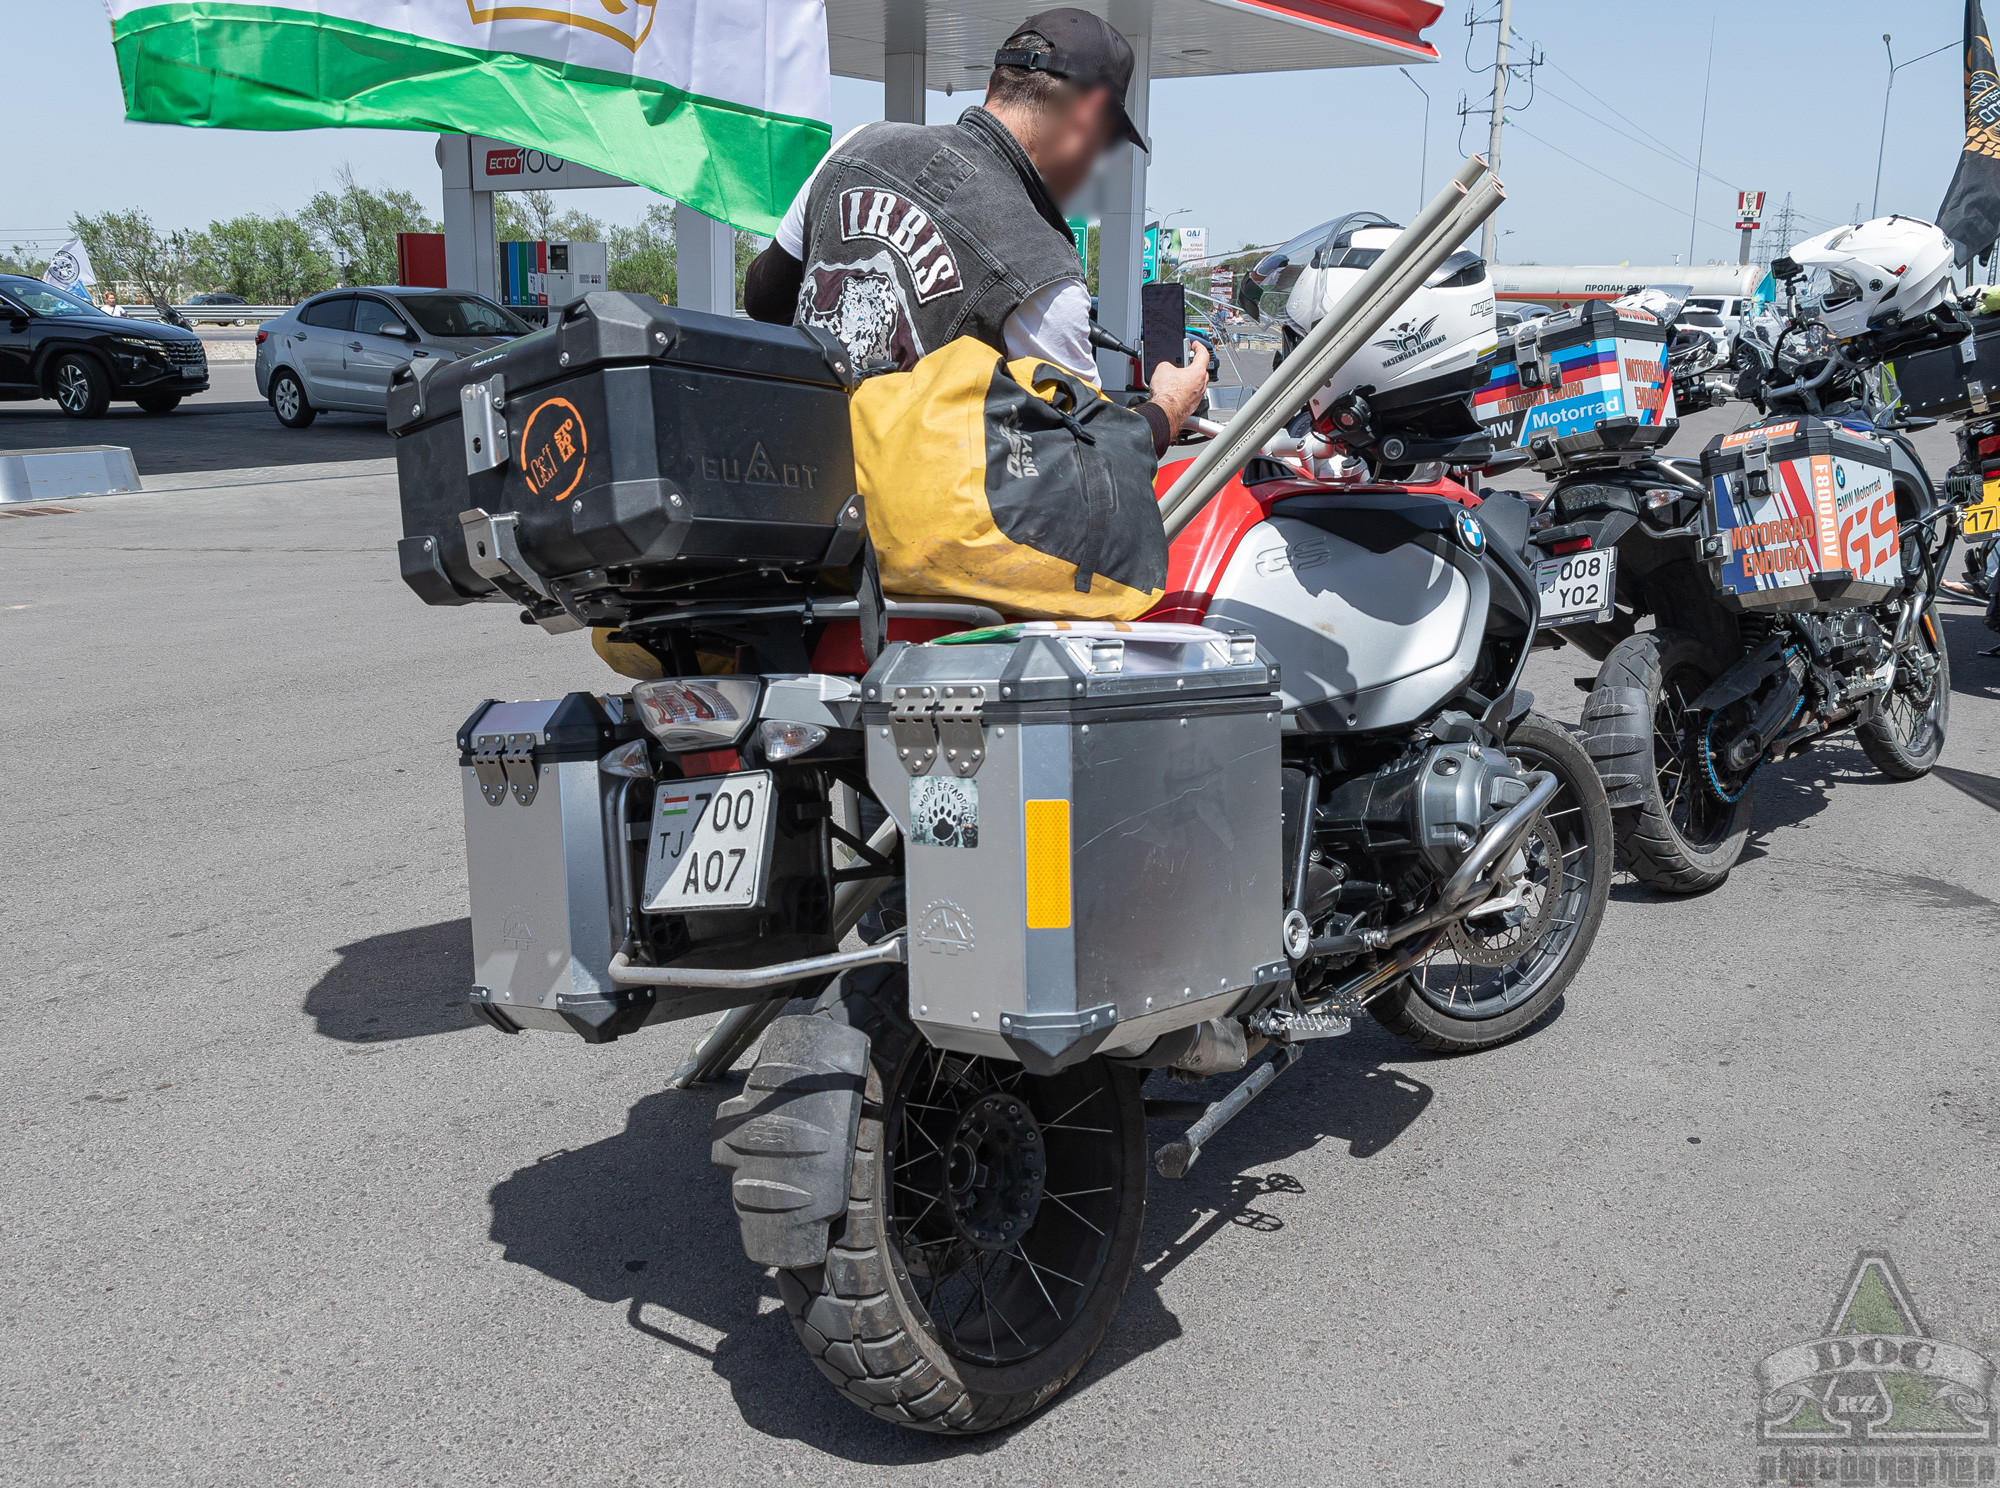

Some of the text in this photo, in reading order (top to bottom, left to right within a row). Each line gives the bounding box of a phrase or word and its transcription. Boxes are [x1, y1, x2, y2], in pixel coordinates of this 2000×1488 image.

[848, 191, 955, 294] IRBIS
[1381, 334, 1447, 369] НАЗЕМНАЯ АВИАЦИЯ
[1625, 358, 1665, 384] MOTORRAD
[1498, 381, 1585, 415] MOTORRAD ENDURO
[1532, 396, 1620, 430] Motorrad
[1635, 387, 1665, 411] ENDURO
[1814, 464, 1839, 557] F800ADV
[1837, 476, 1882, 512] BMW Motorrad
[1730, 514, 1815, 551] MOTORRAD
[1840, 490, 1900, 580] GS
[1967, 509, 1993, 531] 17
[1560, 557, 1601, 581] 008
[1742, 545, 1809, 577] ENDURO
[1540, 580, 1556, 595] TJ
[1559, 584, 1599, 608] Y02
[691, 789, 754, 833] 700
[918, 781, 969, 811] МОТО БЕРЛОГА
[660, 831, 685, 860] TJ
[682, 848, 747, 894] A07
